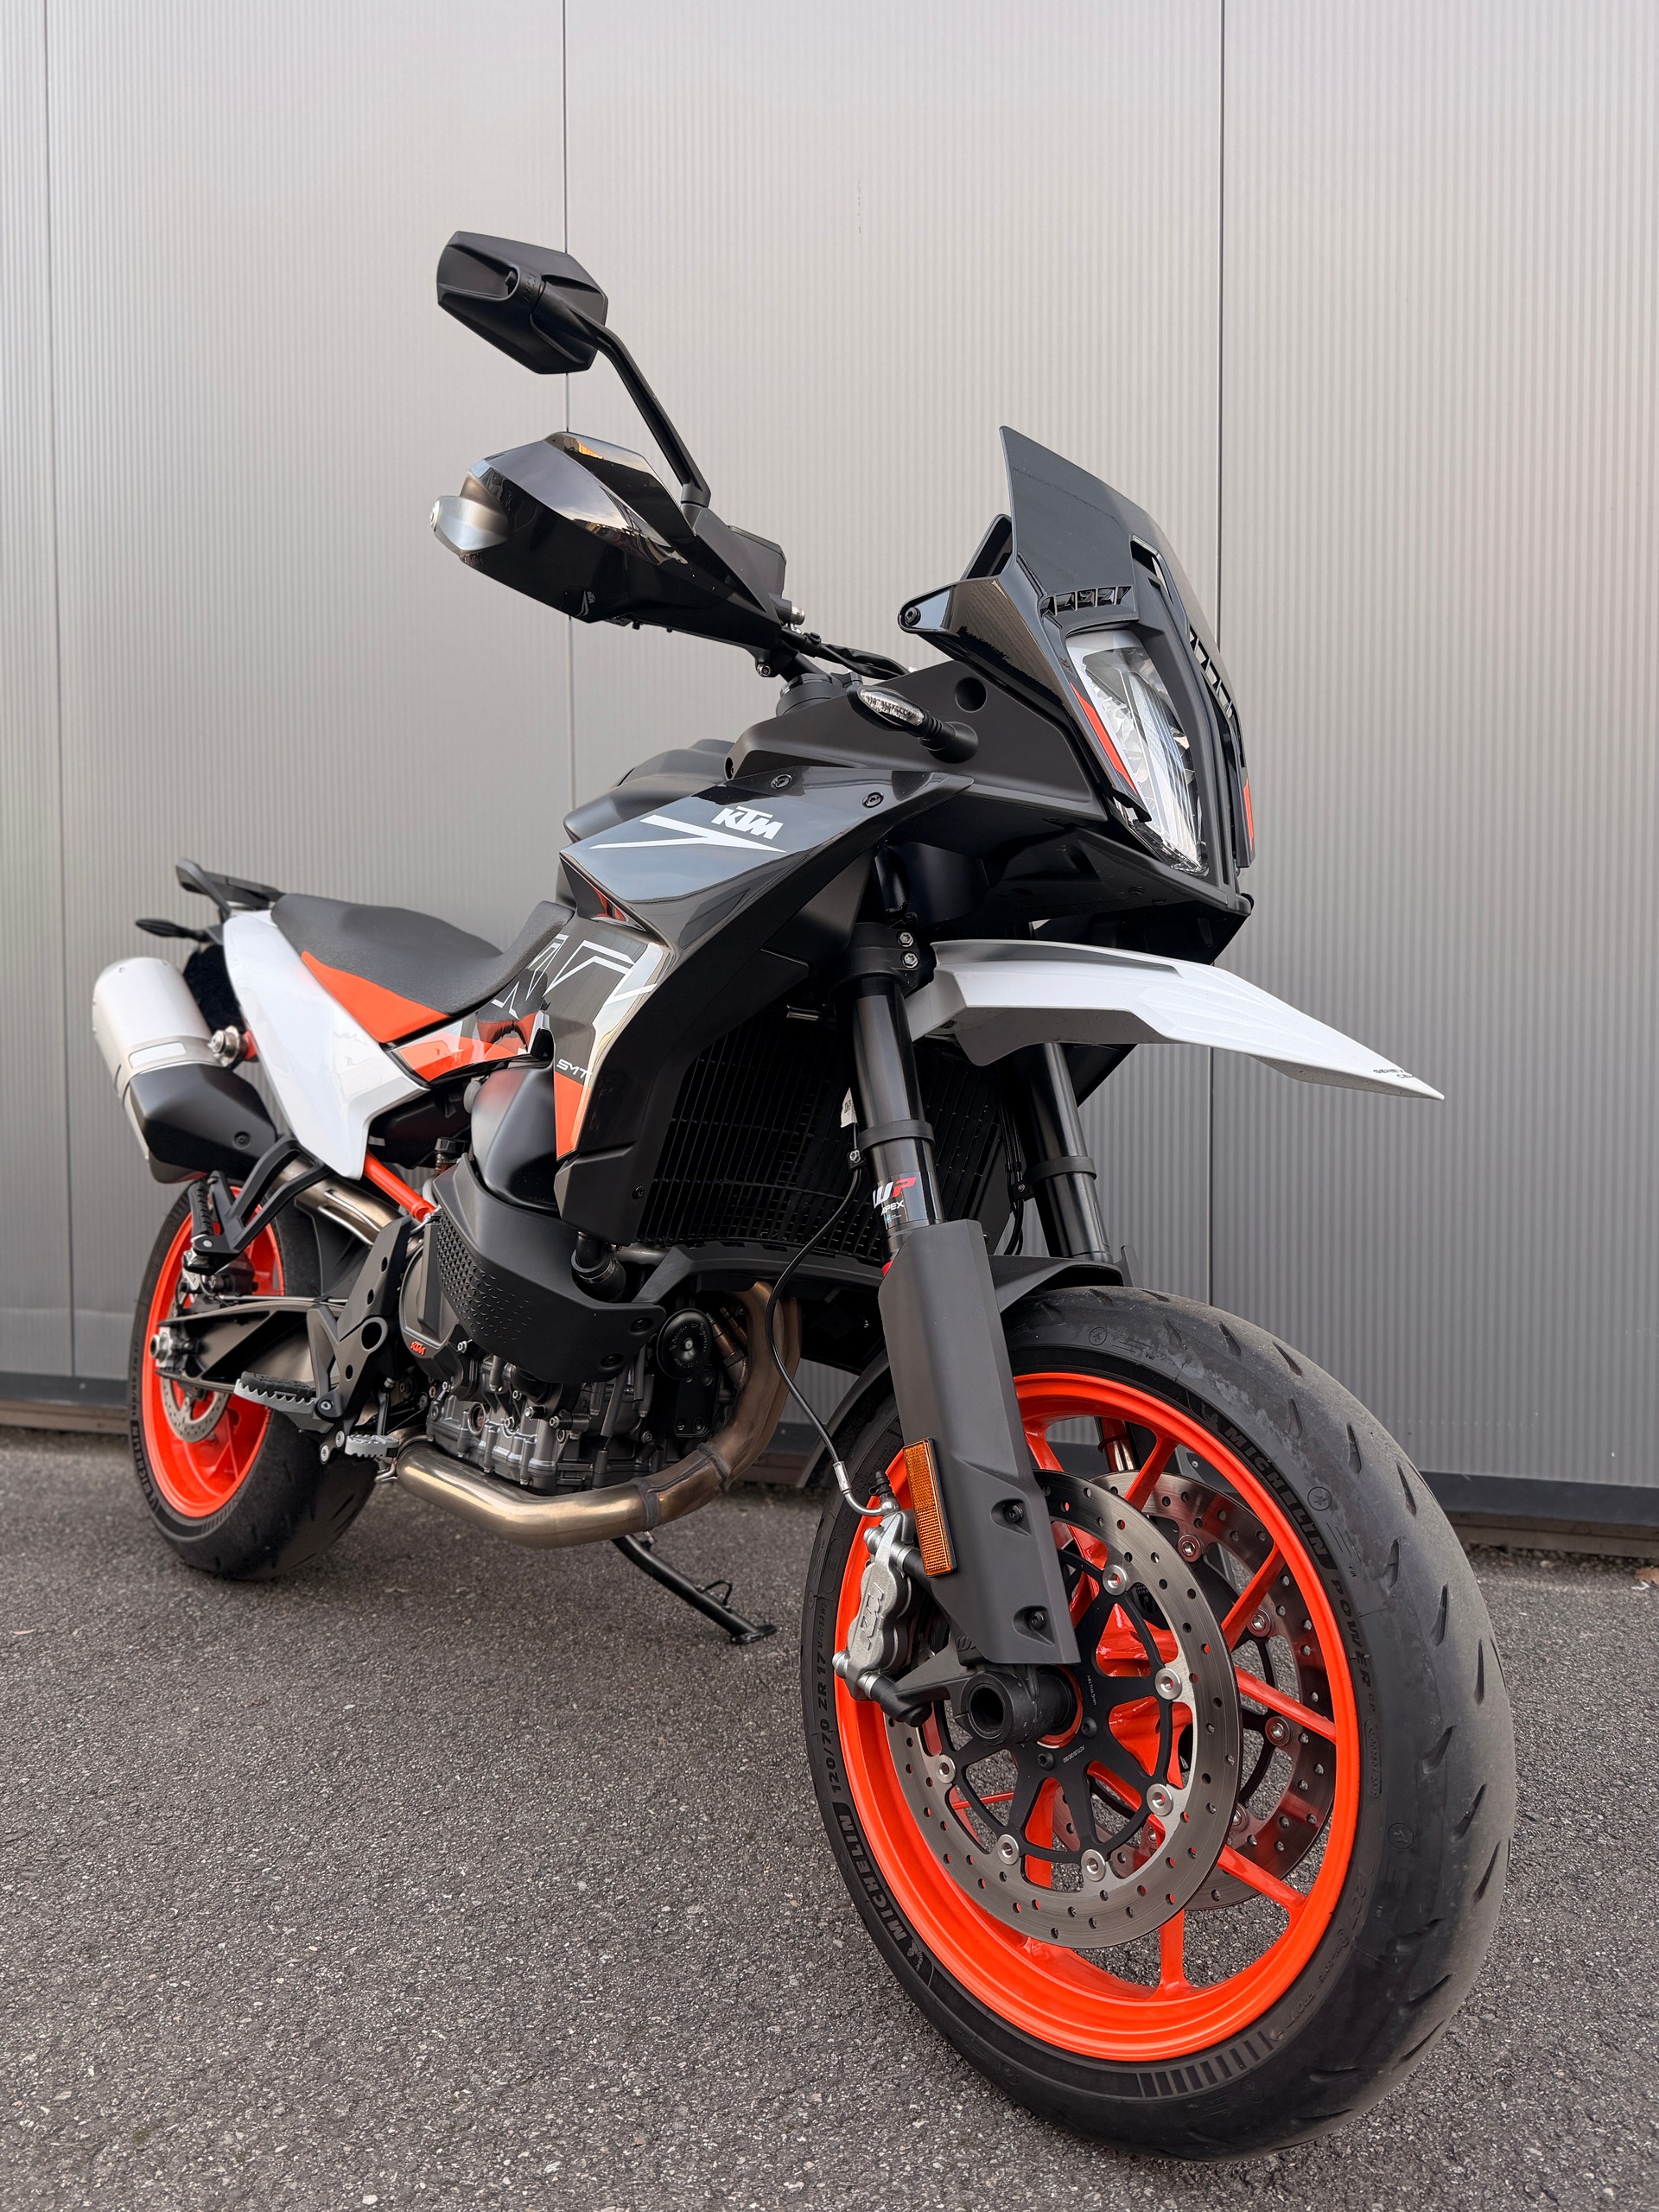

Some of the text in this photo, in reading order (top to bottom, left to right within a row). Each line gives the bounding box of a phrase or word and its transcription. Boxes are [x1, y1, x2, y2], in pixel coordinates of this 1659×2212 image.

[711, 805, 785, 841] KTM
[556, 1058, 593, 1079] SMT
[873, 1176, 917, 1209] WP
[880, 1199, 905, 1216] APEX
[410, 1341, 426, 1356] KTM
[131, 1426, 152, 1493] MICHELIN
[1224, 1427, 1328, 1555] MICHELIN
[860, 1581, 886, 1651] KTM
[1329, 1579, 1373, 1689] POWER
[815, 1651, 827, 1676] 17
[817, 1681, 828, 1711] ZR
[820, 1718, 842, 1793] 120/70
[838, 1815, 908, 1941] MICHELIN
